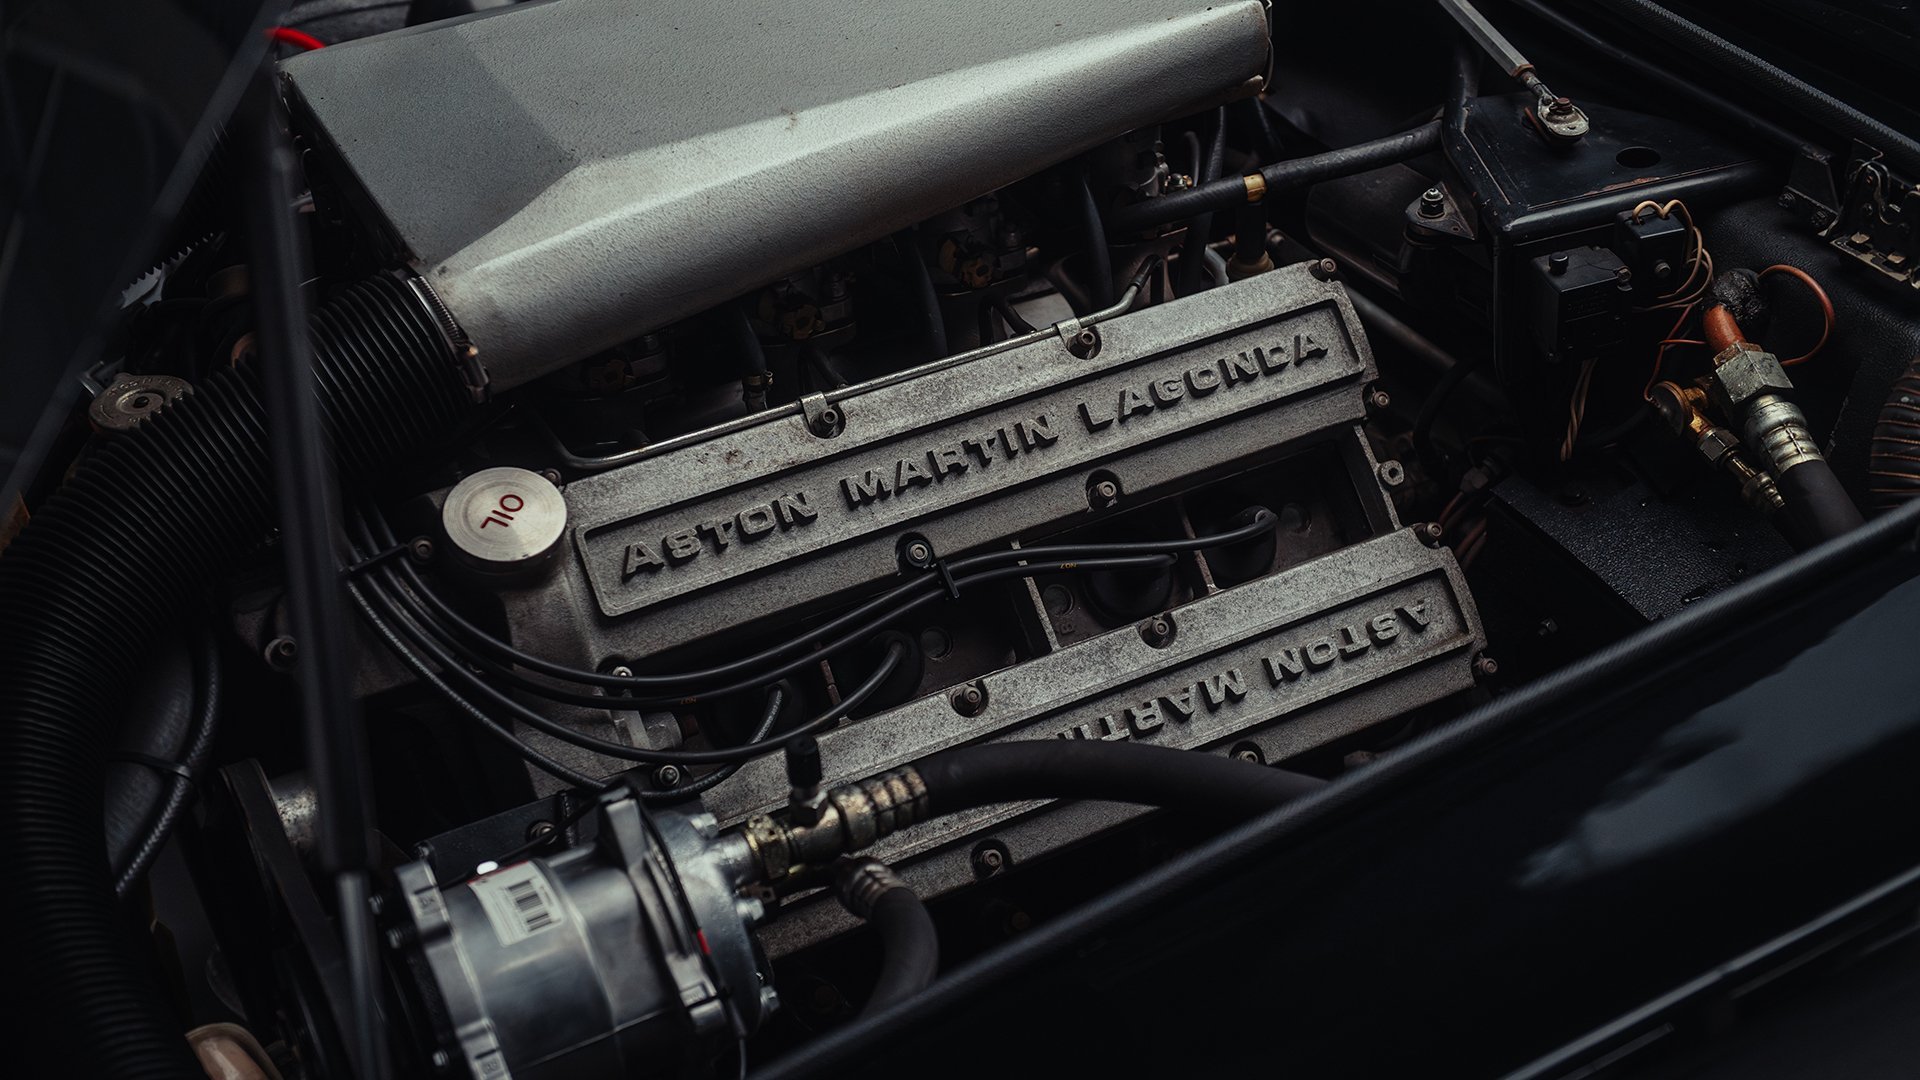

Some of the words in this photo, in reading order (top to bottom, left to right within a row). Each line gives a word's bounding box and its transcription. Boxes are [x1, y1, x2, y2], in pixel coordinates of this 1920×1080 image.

[621, 492, 818, 584] ASTON
[839, 414, 1059, 512] MARTIN
[1078, 334, 1328, 434] LAGONDA
[480, 494, 524, 529] OIL
[1261, 598, 1431, 689] ASTON
[1056, 668, 1248, 742] MARTI
